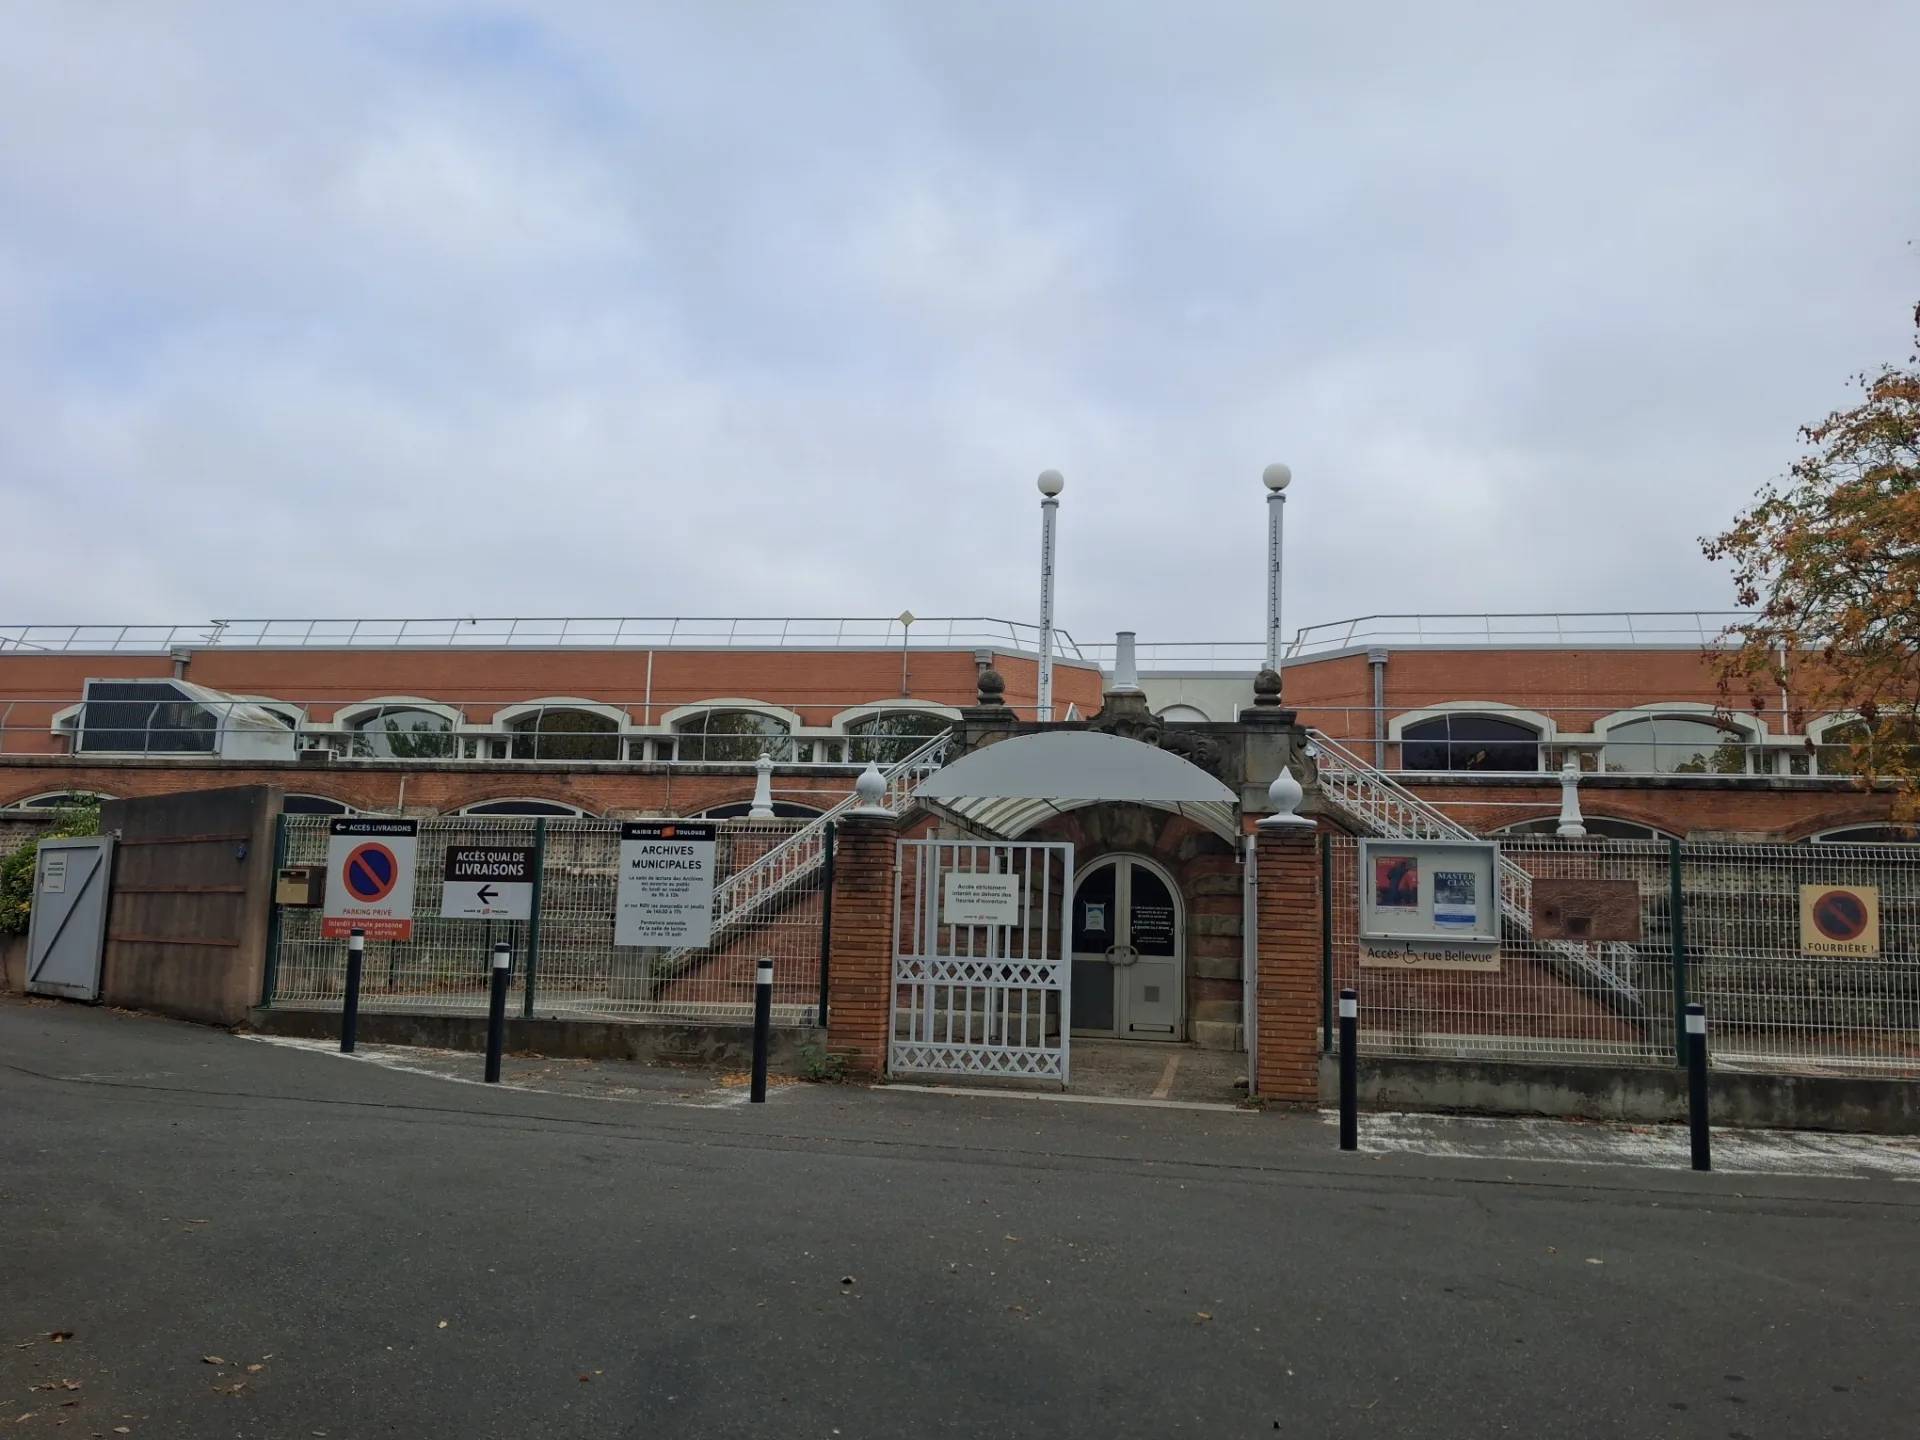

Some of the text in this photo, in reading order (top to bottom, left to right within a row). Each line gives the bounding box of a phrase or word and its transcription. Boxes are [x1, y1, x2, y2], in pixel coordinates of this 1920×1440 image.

[372, 824, 411, 832] LIVRAISONS
[641, 845, 694, 856] ARCHIVES
[456, 850, 525, 863] ACCÈS QUAI DE
[455, 863, 525, 876] LIVRAISONS
[632, 859, 702, 870] MUNICIPALES
[343, 907, 371, 916] PARKING
[1808, 942, 1868, 953] FOURRIÈRE
[1367, 947, 1492, 962] Accès rue Bellevue
